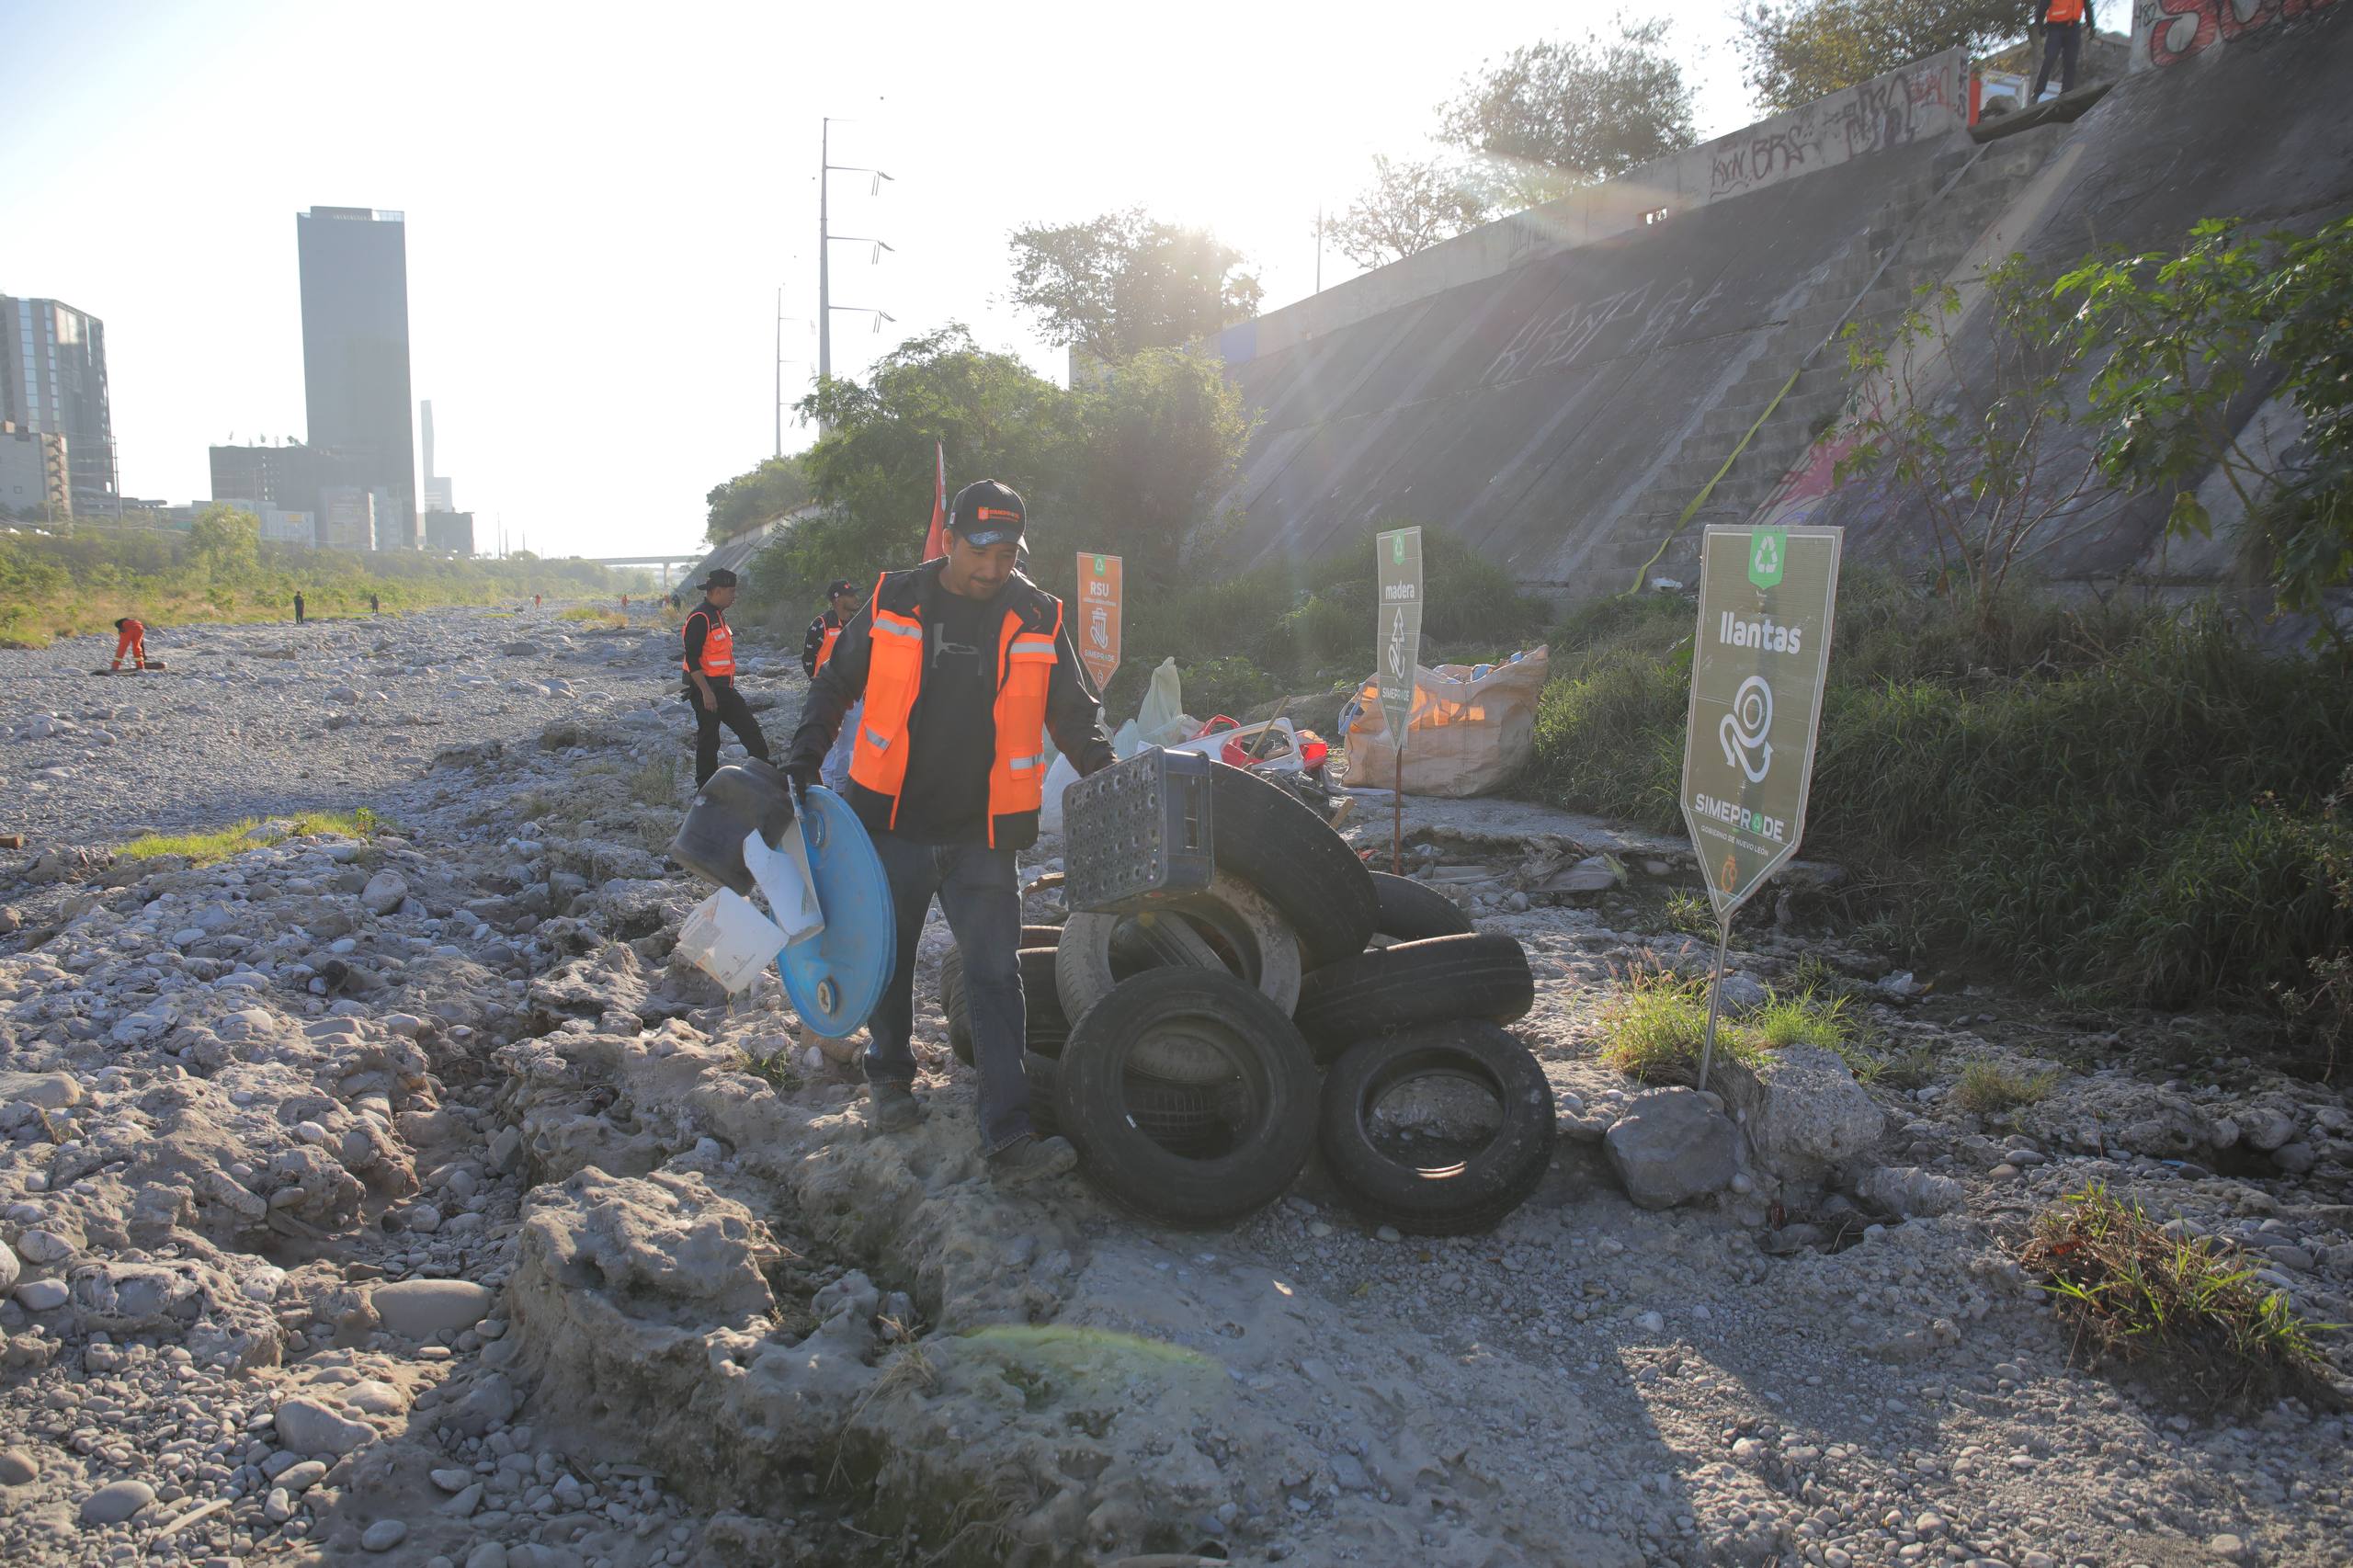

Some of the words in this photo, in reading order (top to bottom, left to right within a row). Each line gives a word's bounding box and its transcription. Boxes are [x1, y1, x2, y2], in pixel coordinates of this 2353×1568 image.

[1089, 580, 1109, 597] RSU
[1385, 580, 1415, 600] madera
[1720, 610, 1802, 655] llantas
[1700, 824, 1727, 842] GOBIERNO
[1735, 838, 1755, 851] NUEVO
